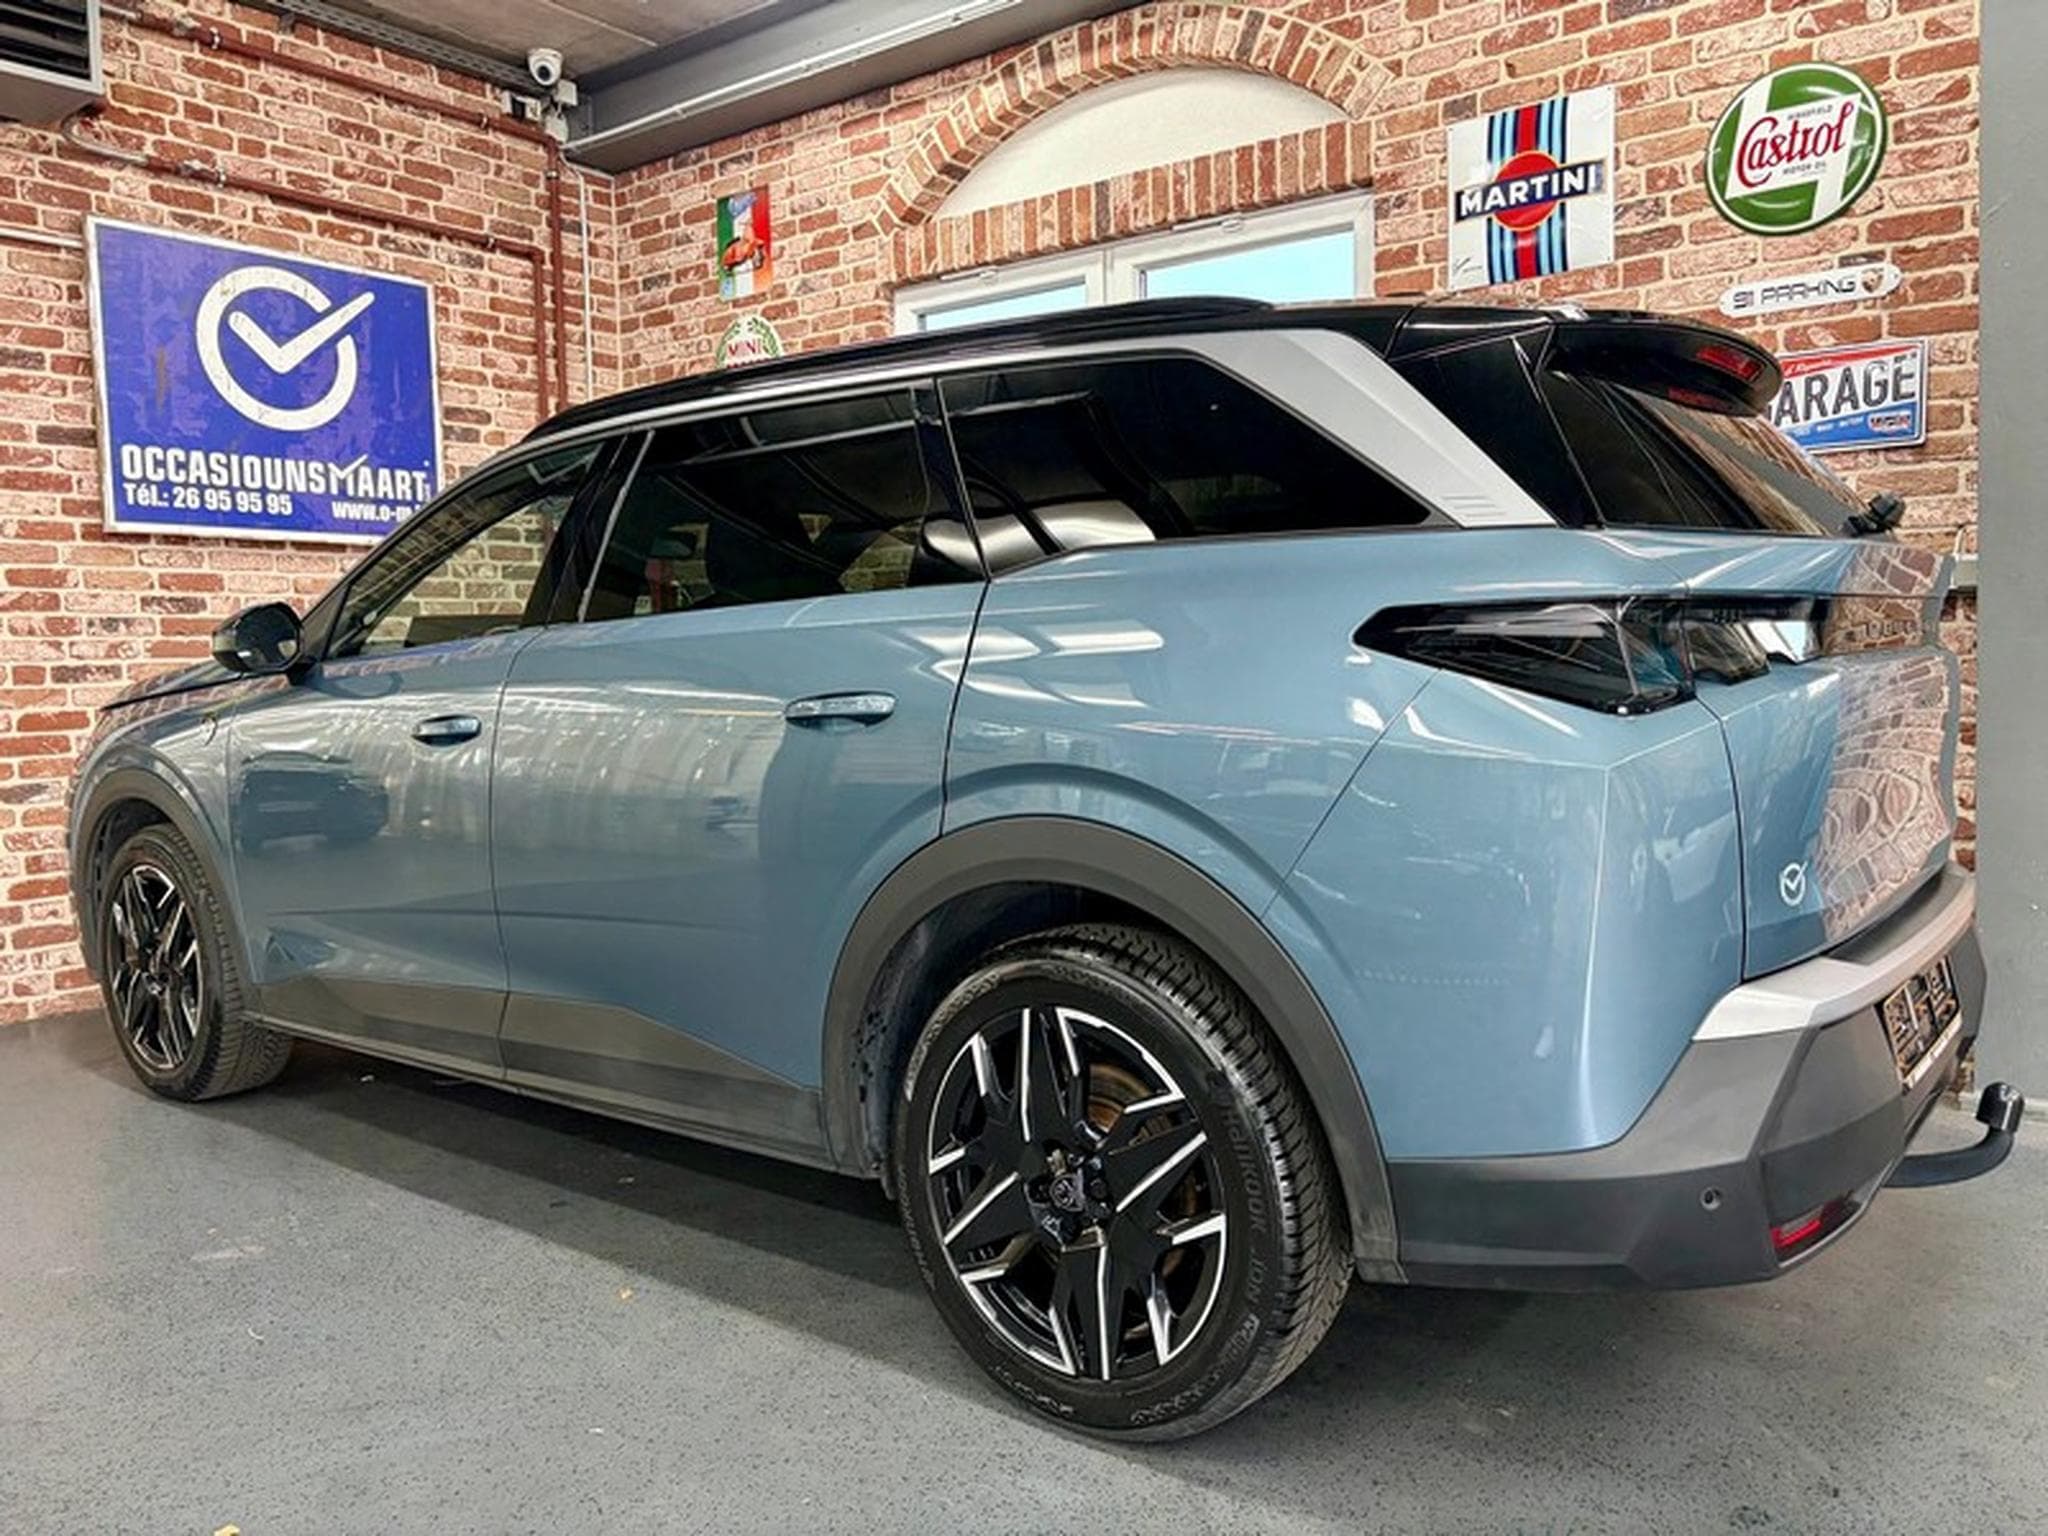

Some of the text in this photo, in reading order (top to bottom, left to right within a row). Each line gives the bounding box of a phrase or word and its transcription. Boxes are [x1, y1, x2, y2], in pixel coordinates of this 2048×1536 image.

[1737, 101, 1854, 188] Castrol
[1460, 164, 1597, 217] MARTINI
[1760, 275, 1857, 305] PARKING
[1767, 352, 1917, 428] ARAGE
[121, 444, 427, 502] OCCASIOUNSMAART
[172, 486, 201, 511] 26
[204, 488, 232, 512] 95
[235, 490, 263, 515] 95
[266, 493, 294, 517] 95
